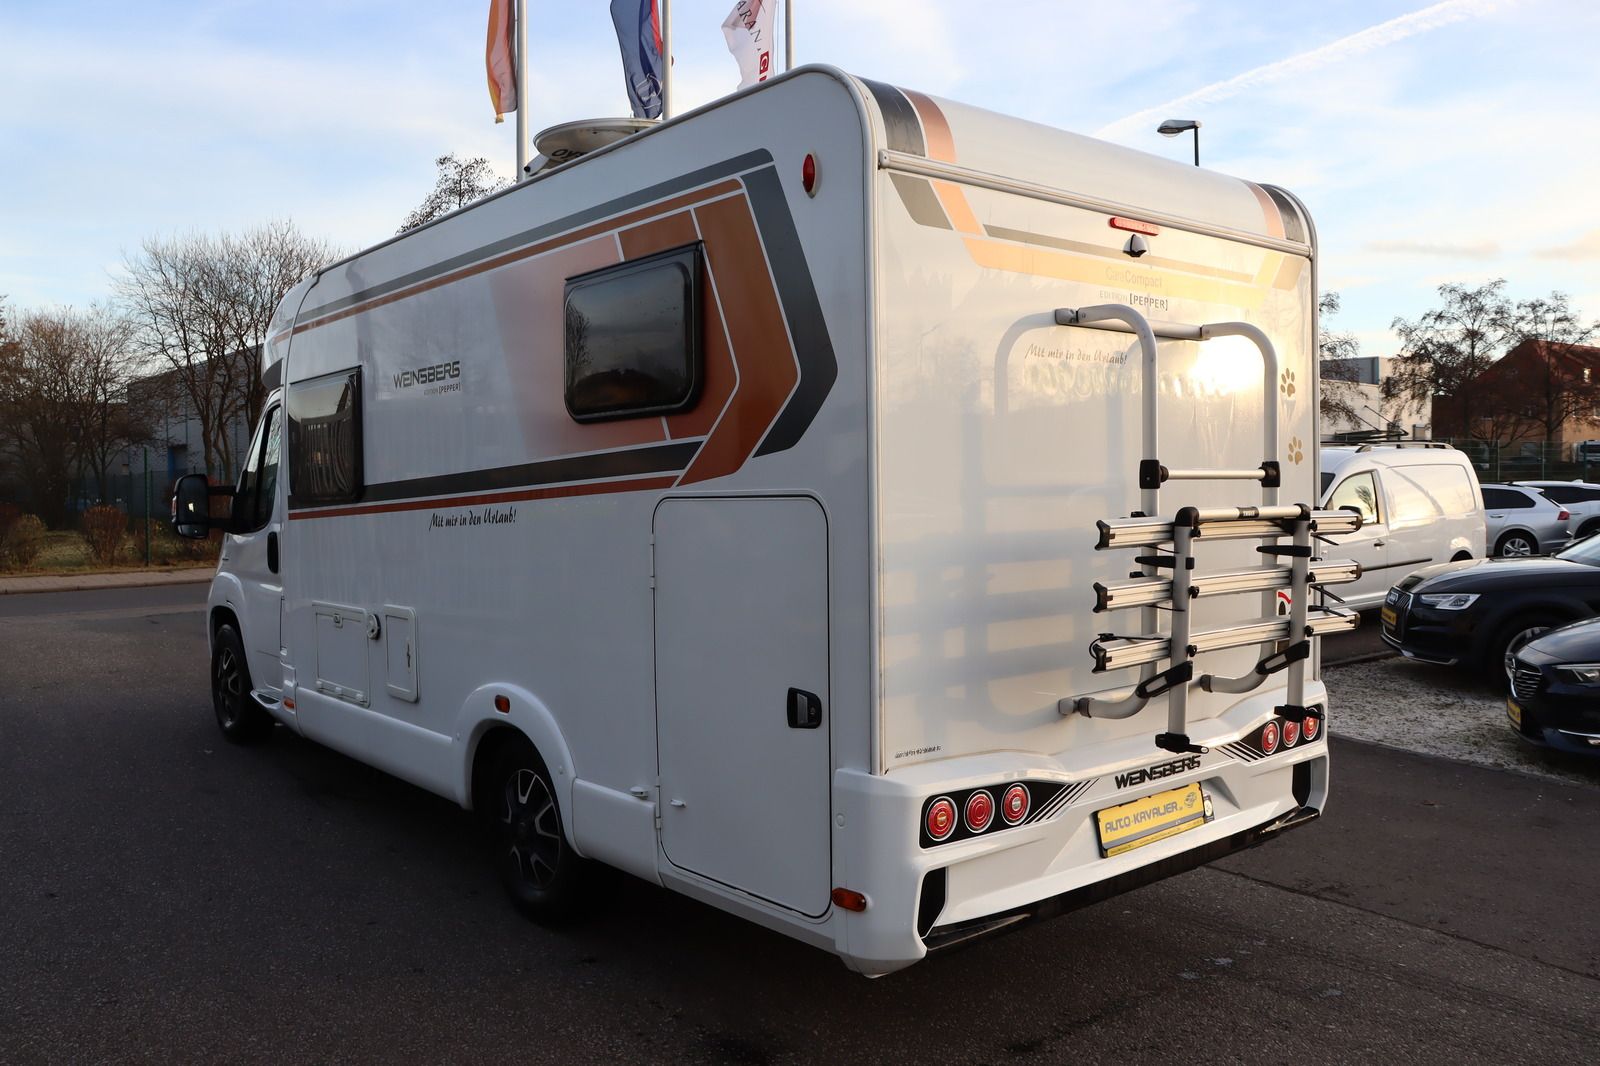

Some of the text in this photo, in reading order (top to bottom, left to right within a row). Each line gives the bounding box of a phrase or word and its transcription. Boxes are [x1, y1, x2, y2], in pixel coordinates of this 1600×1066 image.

[428, 505, 517, 532] Mit mir in den Urlaub!
